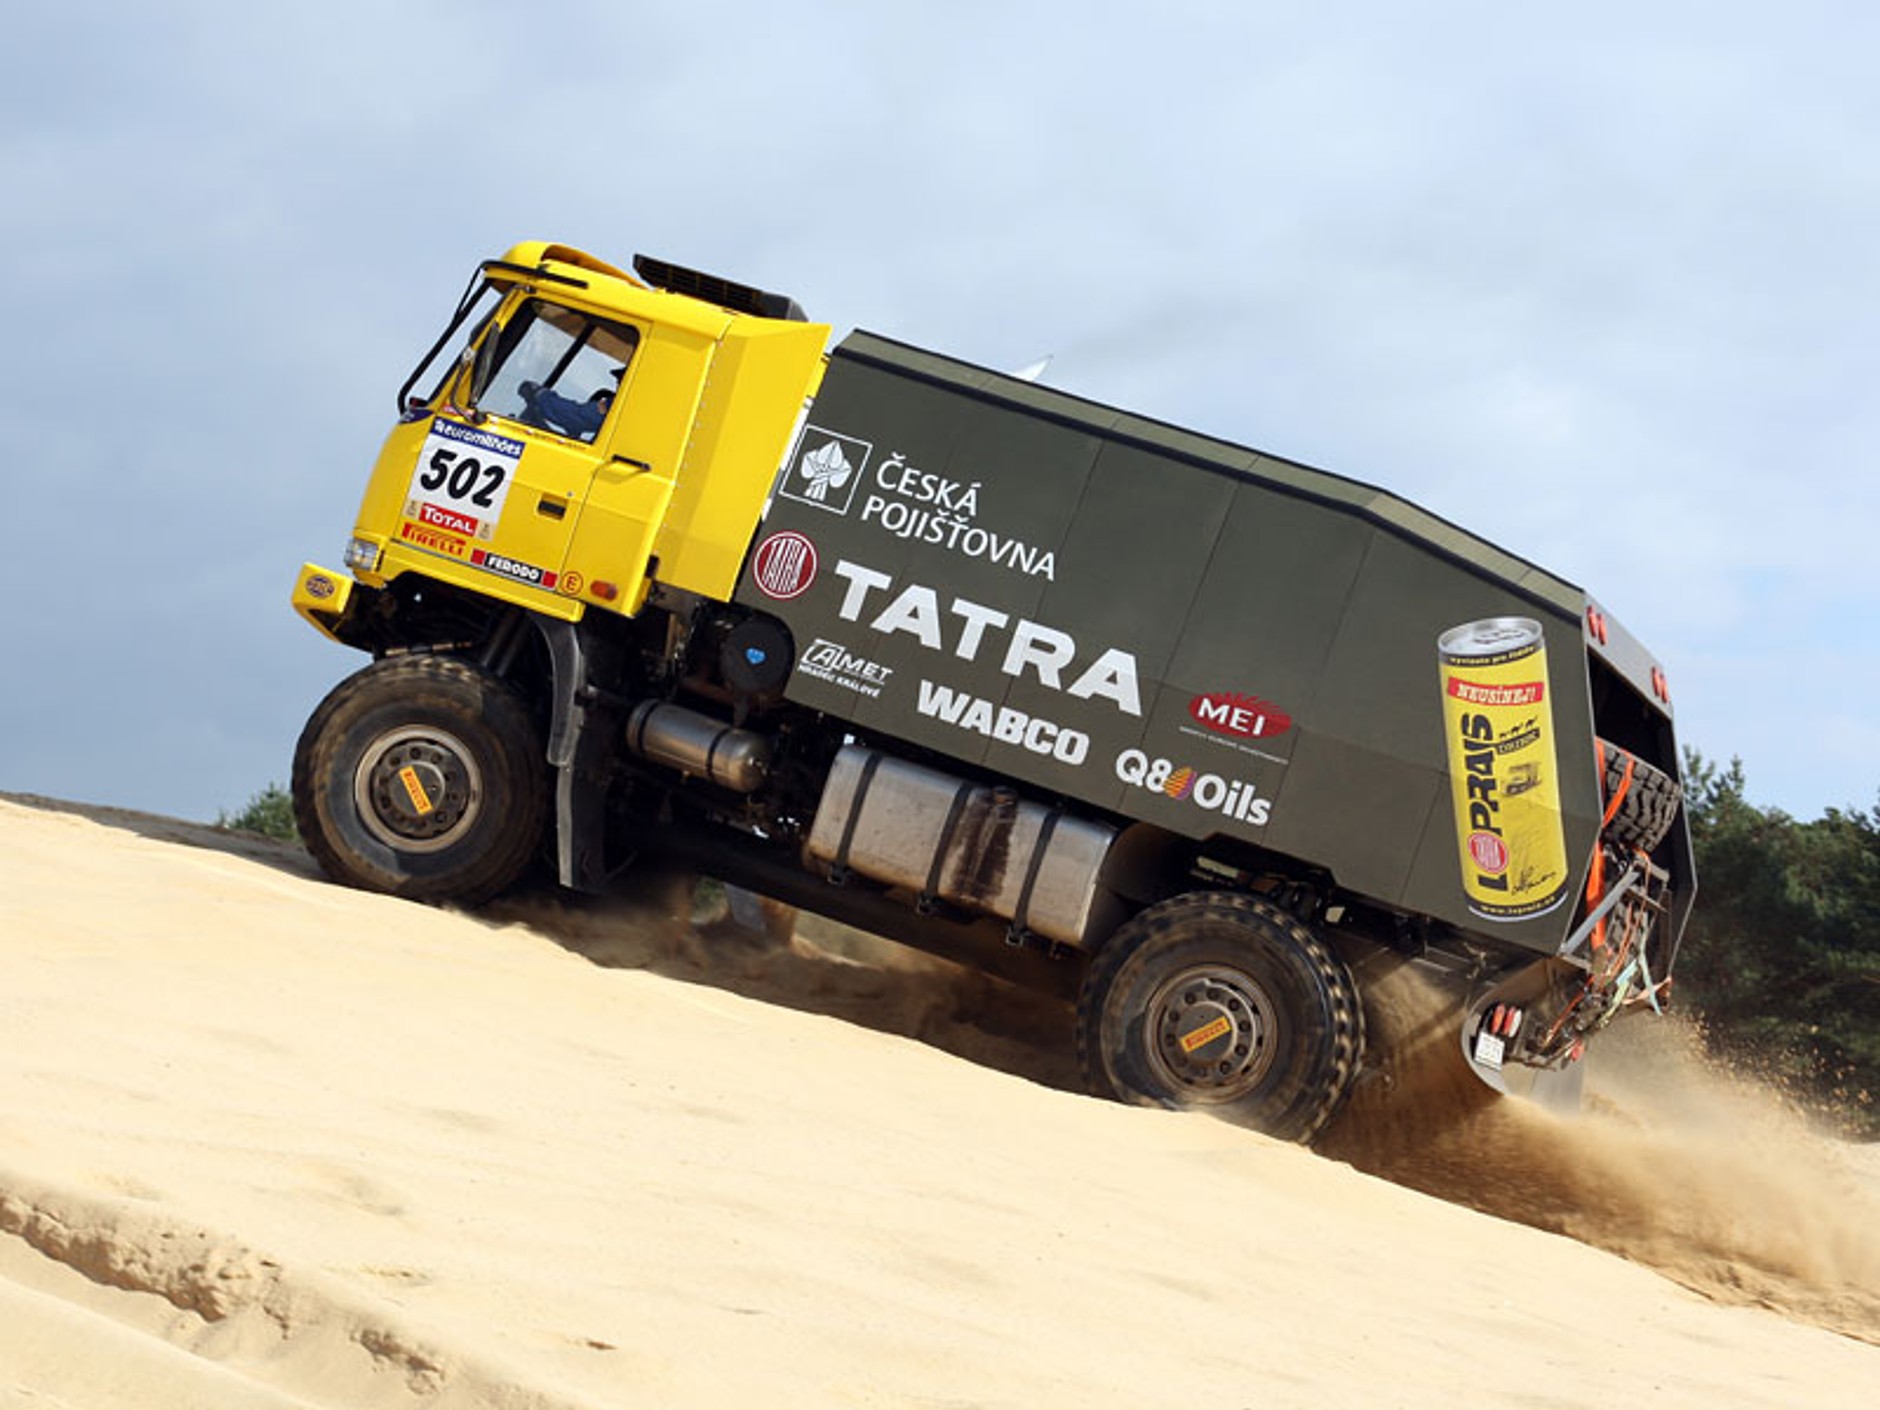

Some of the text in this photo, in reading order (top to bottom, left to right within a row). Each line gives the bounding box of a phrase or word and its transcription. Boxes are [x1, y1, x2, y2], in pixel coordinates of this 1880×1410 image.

[420, 447, 507, 509] 502
[876, 451, 982, 517] ČESKÁ
[402, 522, 467, 556] PIRELLI
[488, 555, 540, 581] FERODO
[860, 494, 1056, 582] POJIŠŤOVNA
[835, 559, 1143, 718] TATRA
[917, 678, 1090, 767] WABCO
[1197, 697, 1267, 737] MEI
[1115, 748, 1273, 827] Q8 Oils
